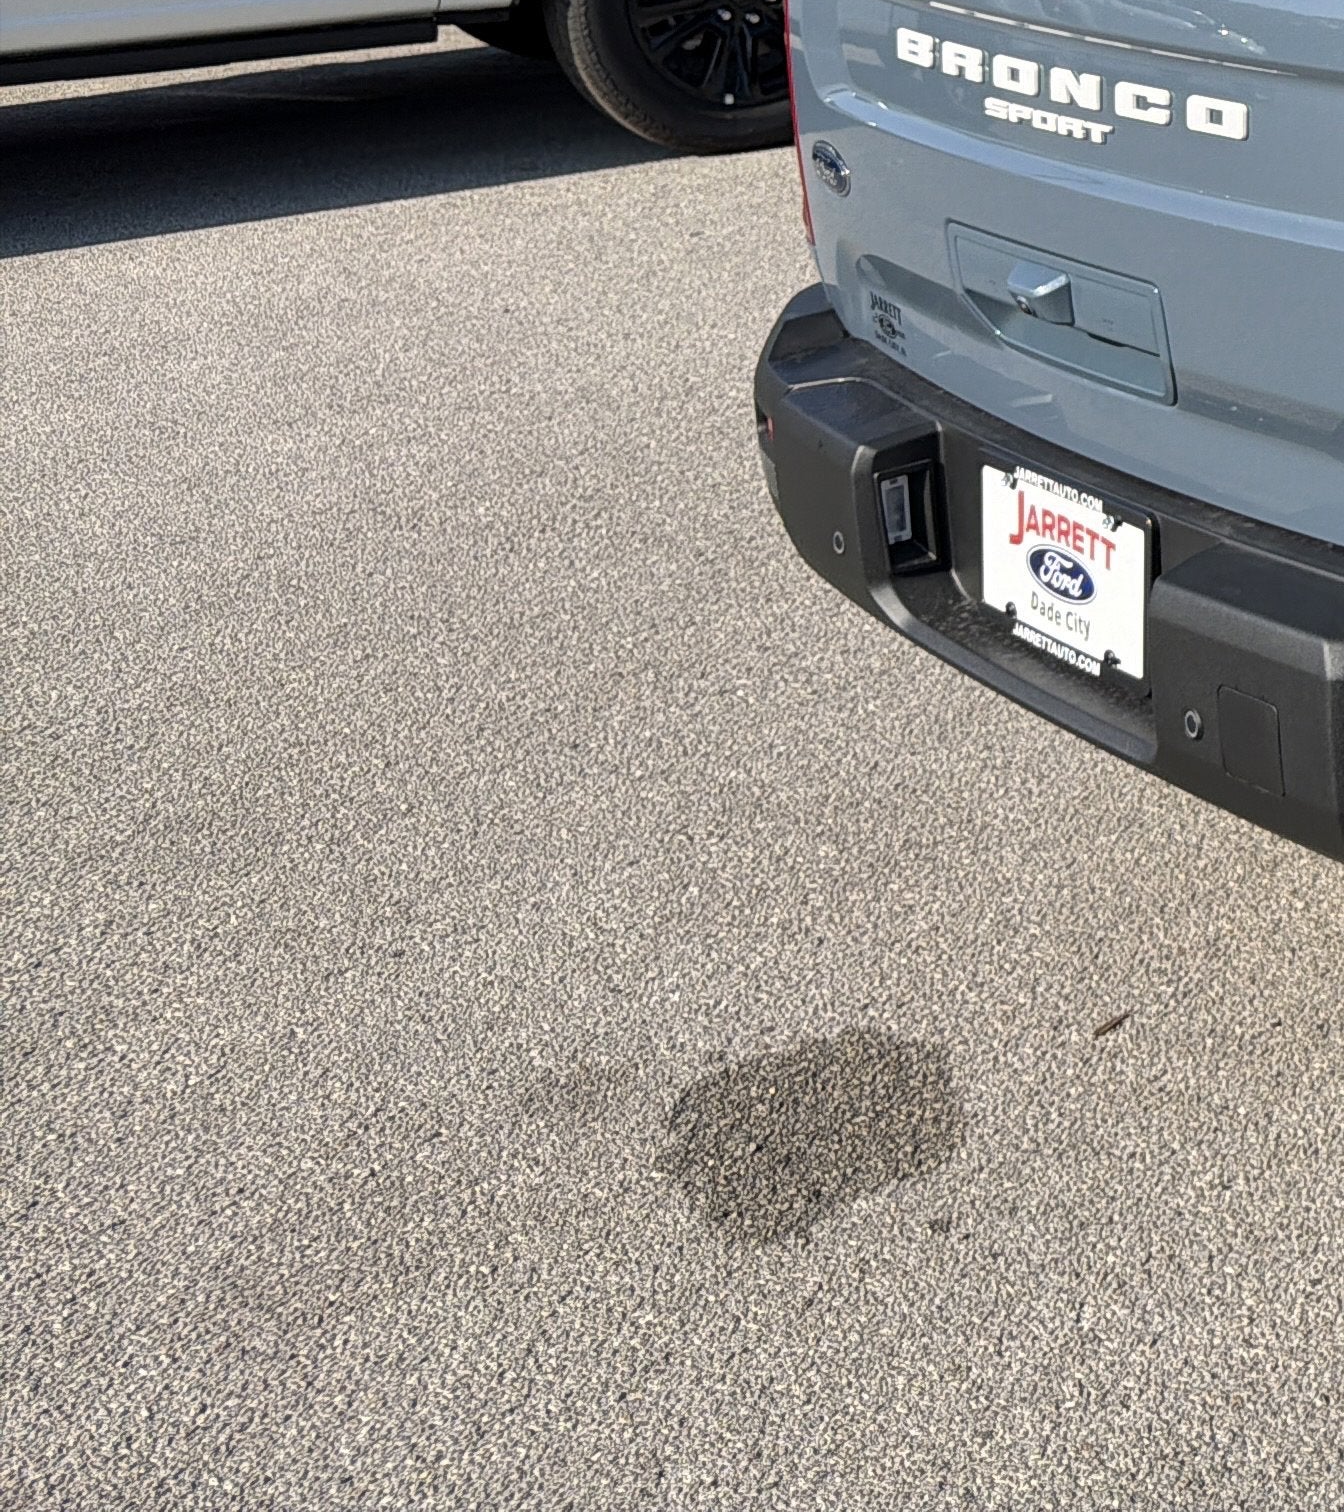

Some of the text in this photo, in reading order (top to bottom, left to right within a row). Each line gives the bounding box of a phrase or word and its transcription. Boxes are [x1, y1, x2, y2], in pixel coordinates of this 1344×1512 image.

[897, 28, 1248, 140] BRONCO
[984, 96, 1114, 144] SPORT
[1015, 466, 1103, 513] JARRETTAUTO.COM
[1009, 490, 1116, 570] JARRETT
[1039, 552, 1084, 597] Ford
[1031, 591, 1090, 641] Dade City
[1013, 622, 1100, 676] JARRETTAUTO.COM
